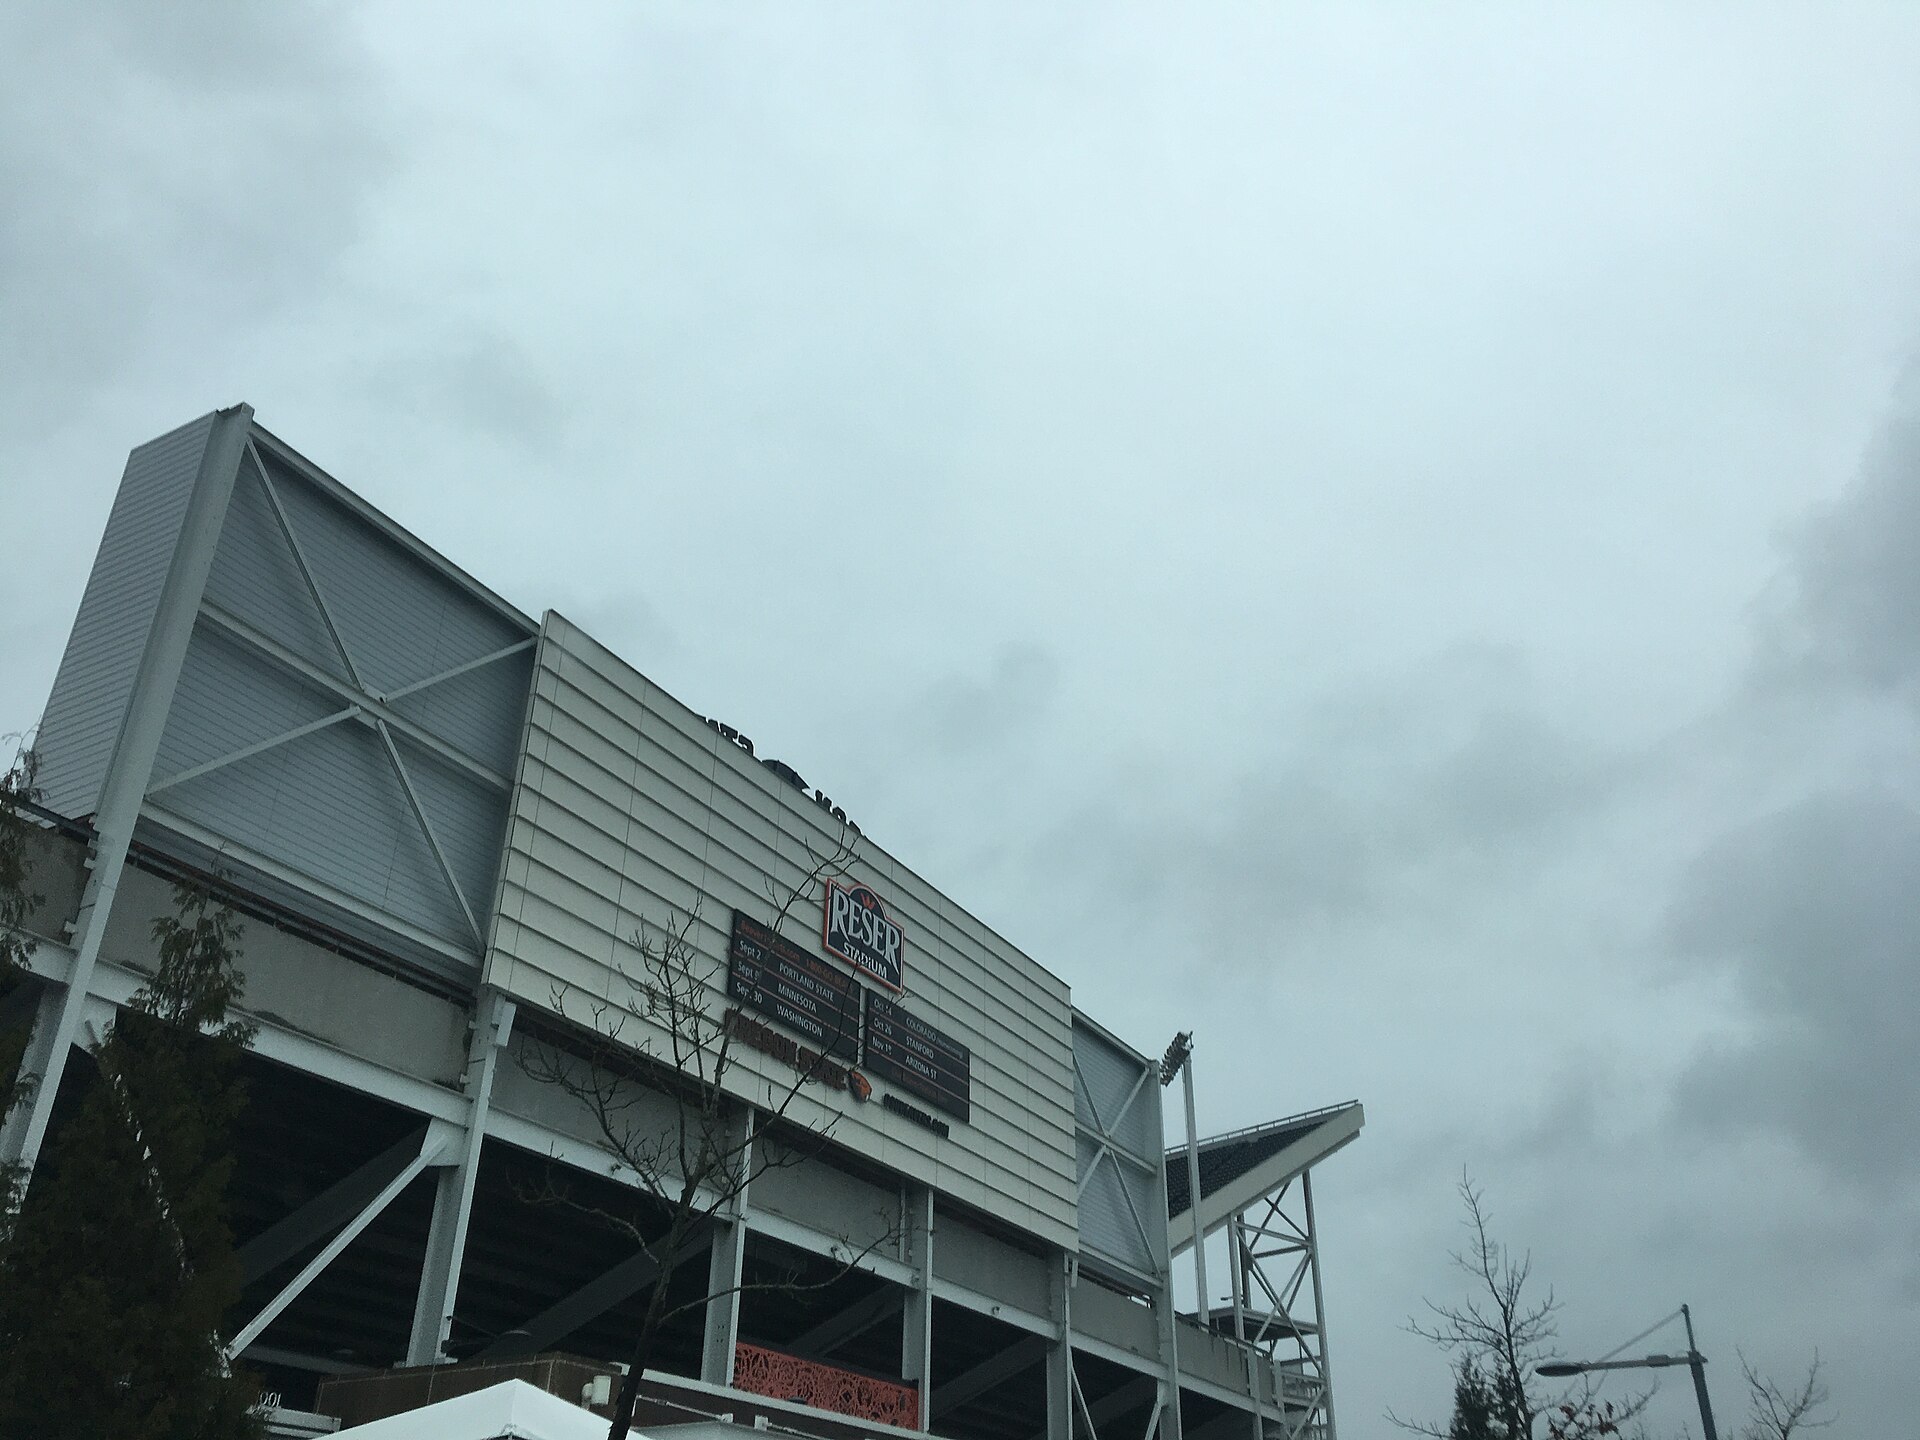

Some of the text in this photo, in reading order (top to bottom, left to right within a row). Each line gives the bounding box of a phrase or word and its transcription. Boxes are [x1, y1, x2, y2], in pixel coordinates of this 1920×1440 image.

[830, 888, 900, 976] RESER
[740, 940, 762, 961] Sept 2
[843, 941, 887, 979] STADIUM
[738, 961, 753, 979] Sept
[779, 962, 834, 1002] PORTLAND STATE
[753, 990, 763, 1004] 30
[778, 983, 817, 1013] MINNESOTA
[874, 998, 884, 1012] Oct
[776, 1003, 823, 1037] WASHINGTON
[874, 1017, 884, 1031] Oct
[906, 1017, 936, 1041] COLORADO
[872, 1035, 884, 1051] Nov
[906, 1035, 934, 1059] STANFORD
[905, 1055, 937, 1080] ARIZONA ST
